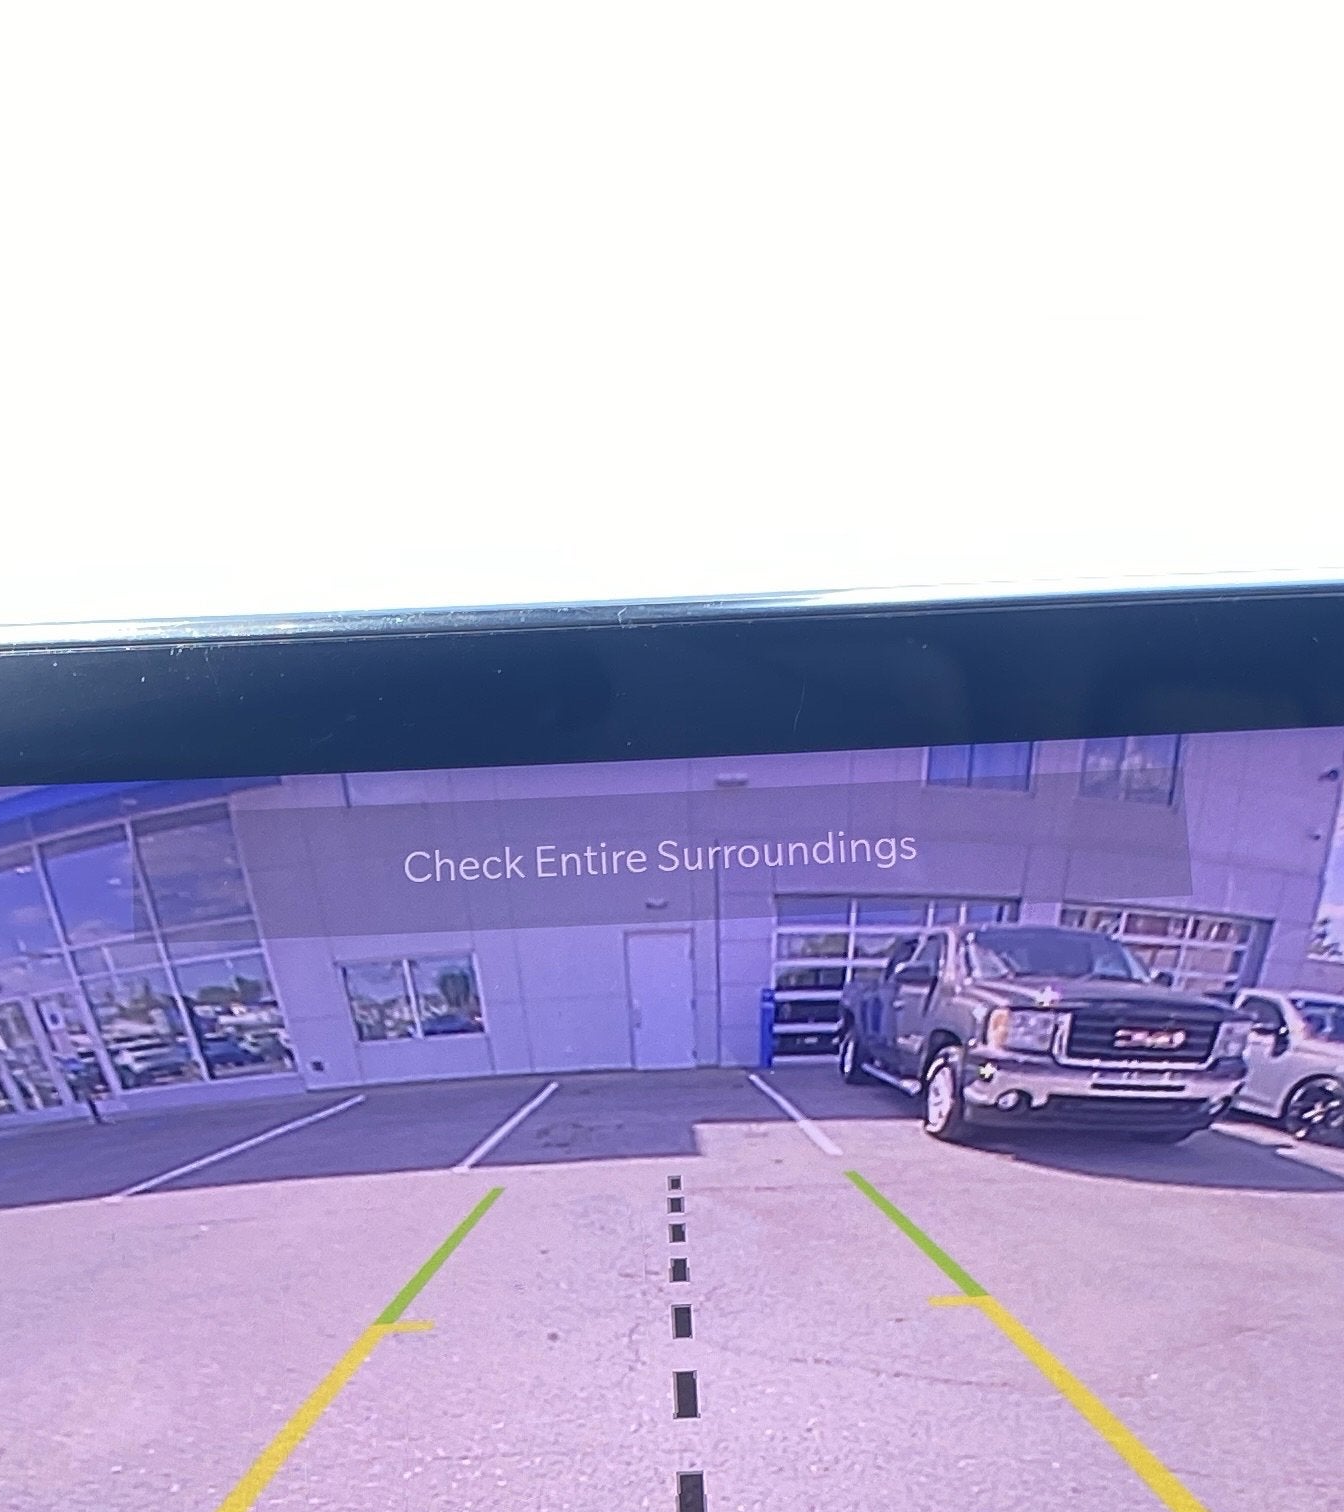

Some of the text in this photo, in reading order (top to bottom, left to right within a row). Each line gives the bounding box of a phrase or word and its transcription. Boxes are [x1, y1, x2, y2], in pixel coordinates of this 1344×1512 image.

[403, 831, 918, 884] Check Entire Surroundings
